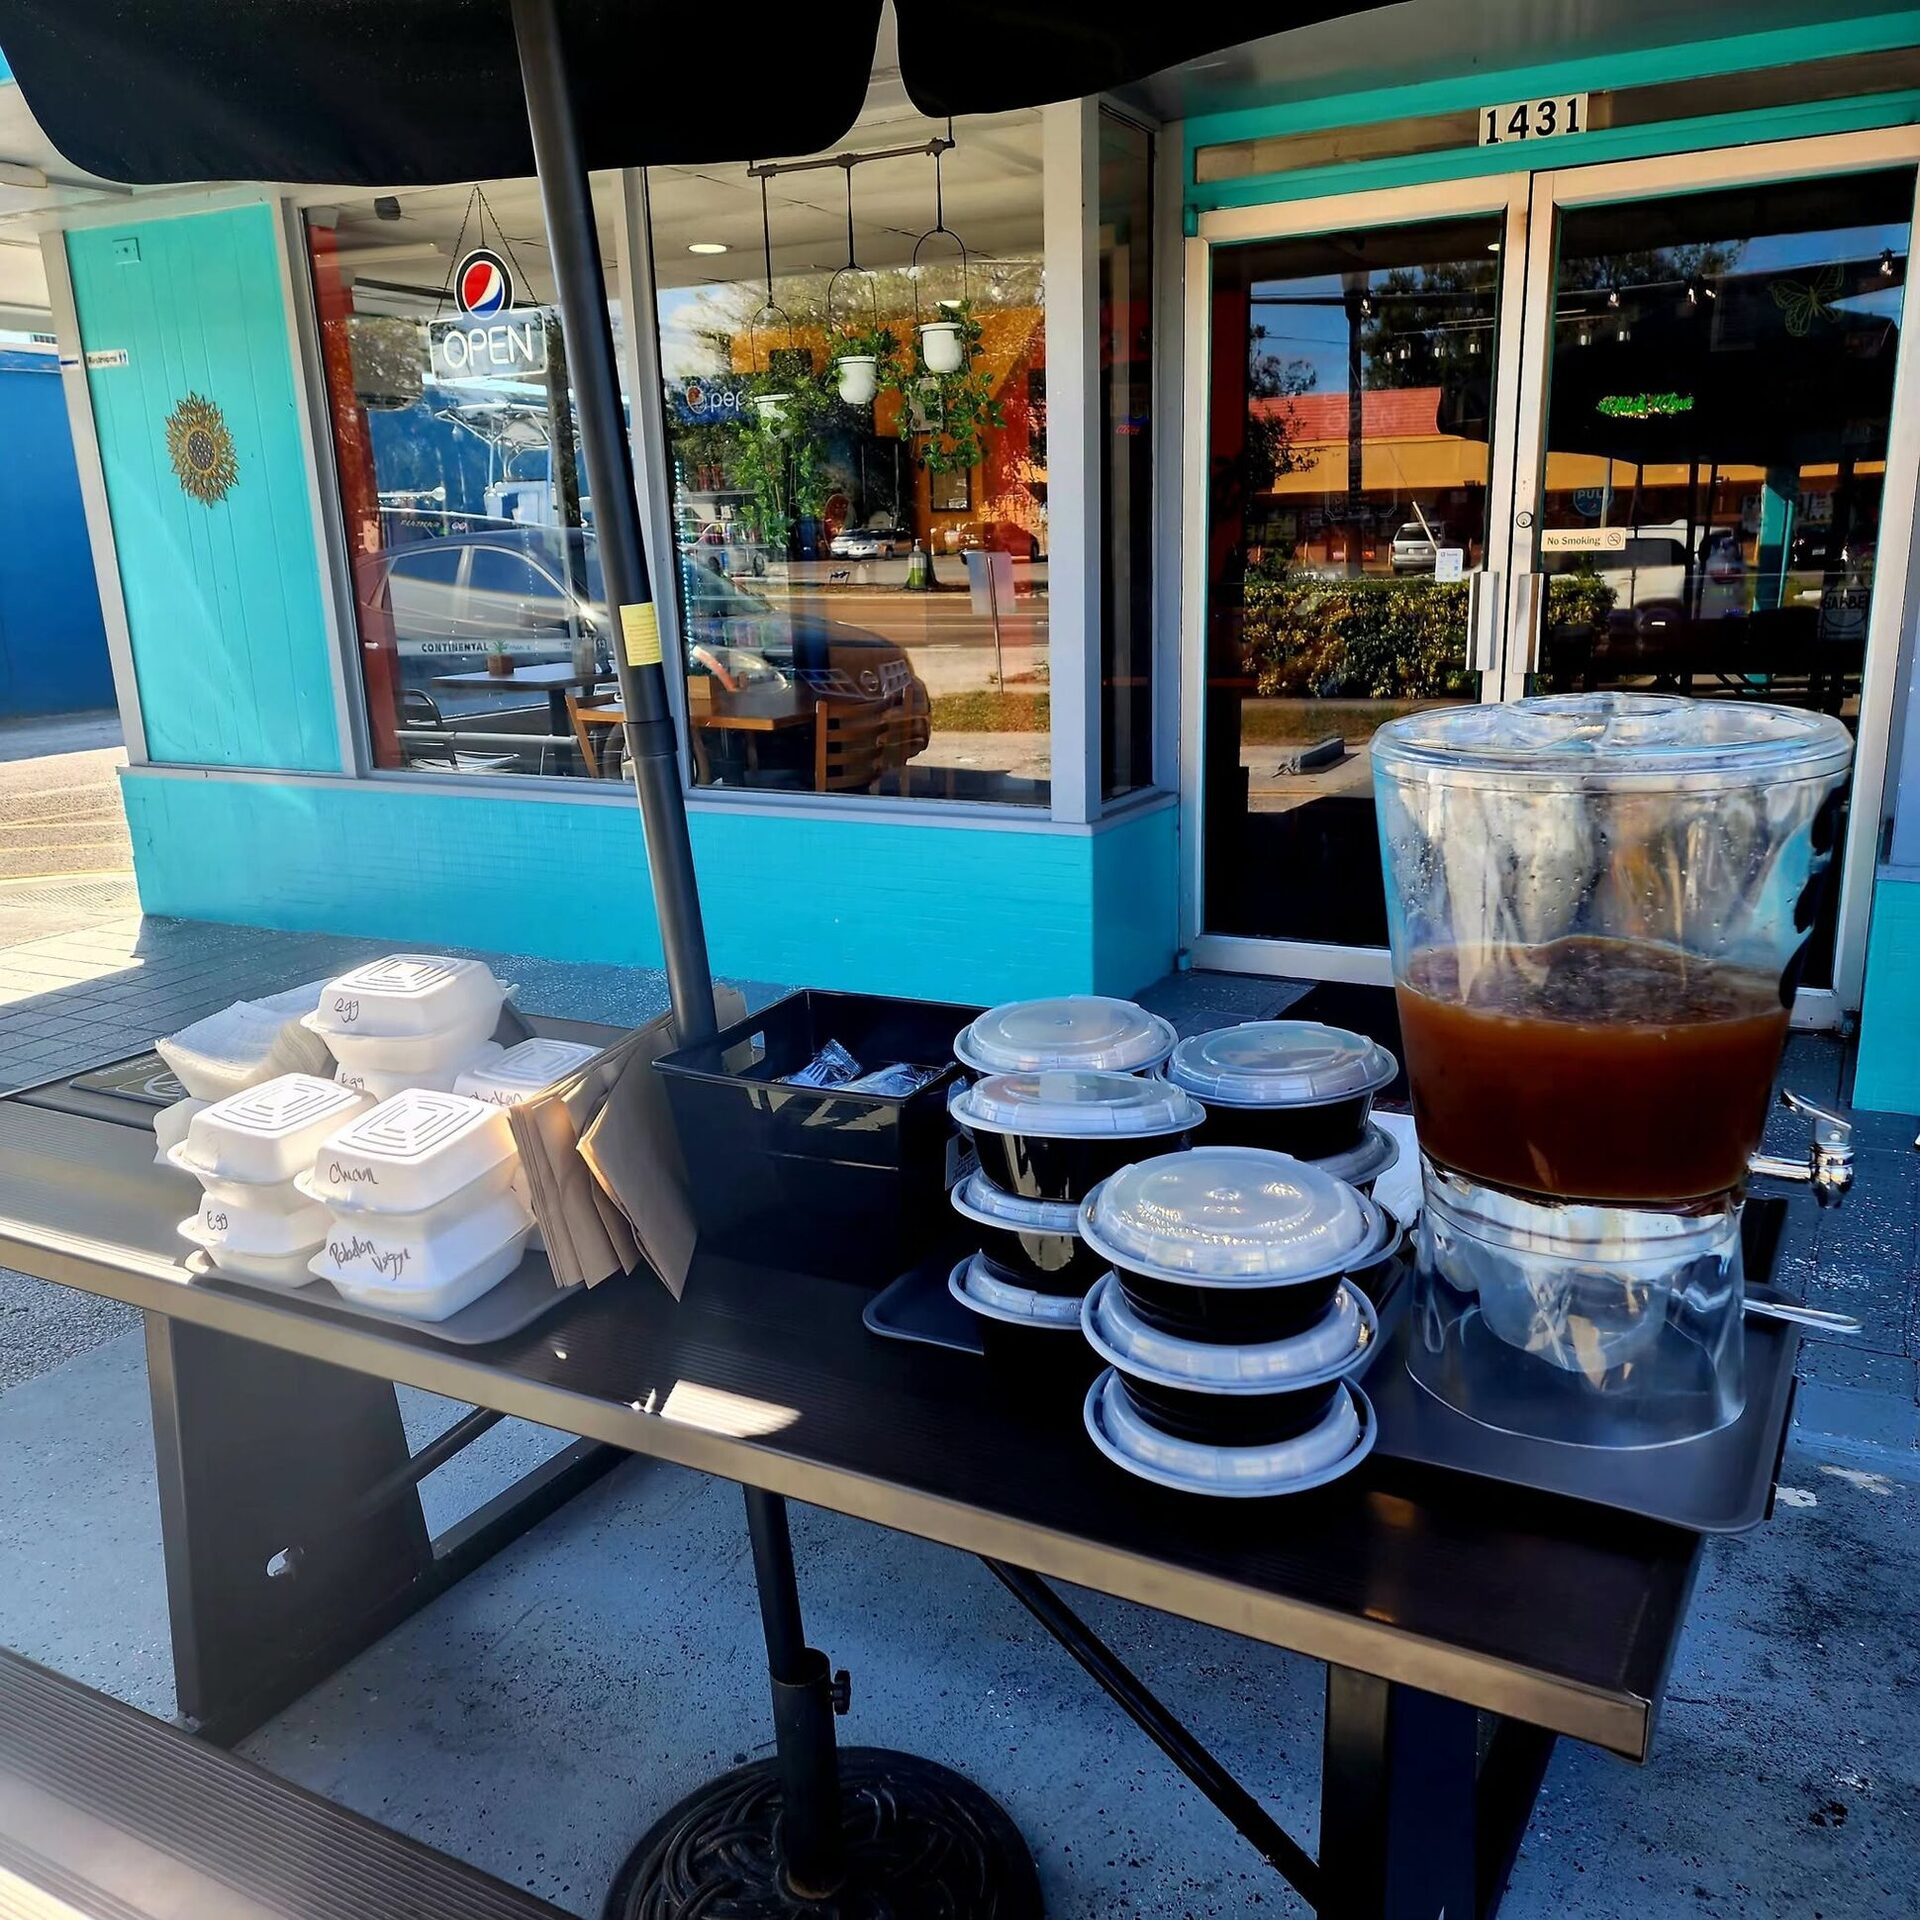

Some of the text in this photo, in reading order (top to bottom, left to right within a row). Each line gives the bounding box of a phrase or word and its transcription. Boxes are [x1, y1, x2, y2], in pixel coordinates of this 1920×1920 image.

[1486, 97, 1580, 145] 1431
[443, 323, 534, 369] OPEN
[1576, 489, 1604, 499] PUL
[1547, 536, 1602, 547] No Smoking
[421, 642, 489, 653] CONTINENTAL
[207, 1210, 228, 1231] Egg
